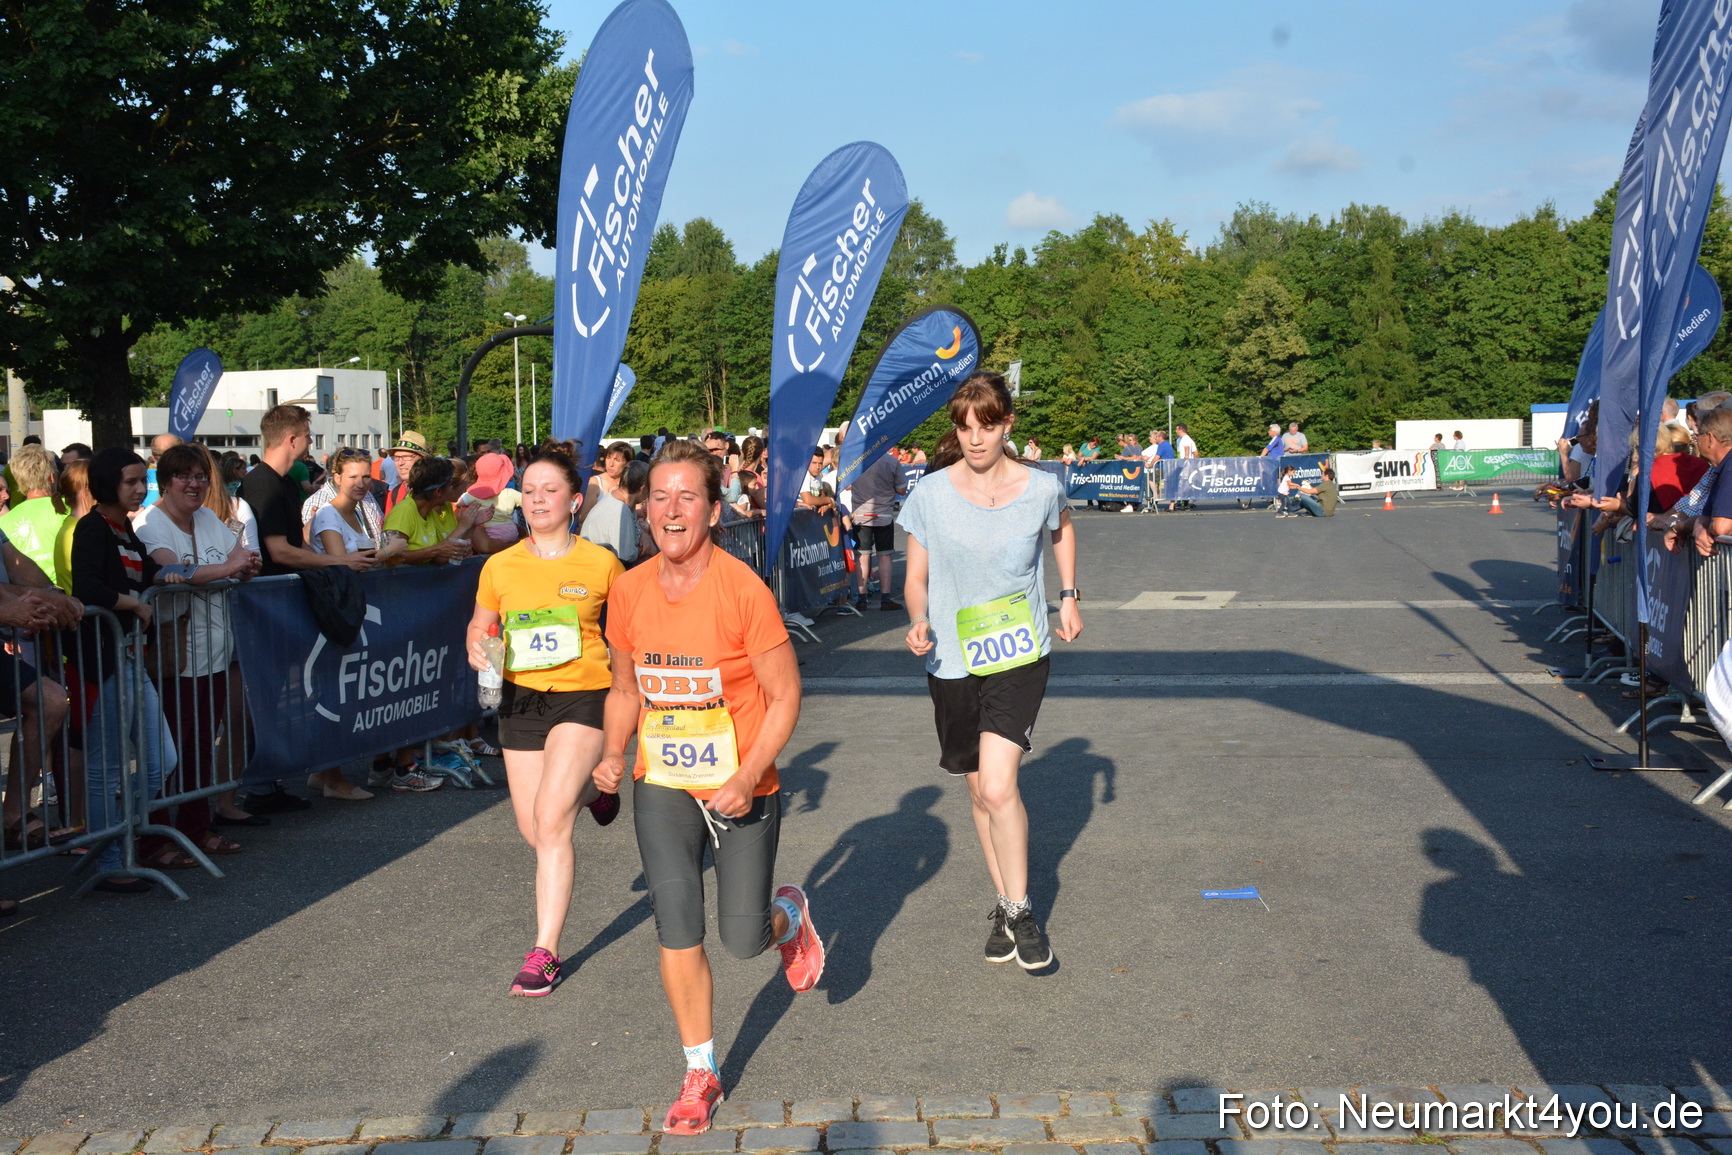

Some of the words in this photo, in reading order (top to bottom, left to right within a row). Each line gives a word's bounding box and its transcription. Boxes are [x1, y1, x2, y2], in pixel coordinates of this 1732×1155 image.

[1665, 0, 1732, 239] Fische
[587, 48, 659, 298] Fischer
[616, 91, 669, 293] AUTOMOBILE
[805, 177, 876, 346] Fischer
[831, 207, 886, 342] AUTOMOBILE
[1677, 308, 1711, 341] Medien
[181, 361, 212, 422] Fischer
[191, 372, 215, 420] AUTOMOBILE
[856, 361, 944, 436] Frischmann
[912, 384, 935, 405] Druck
[947, 353, 975, 380] Medien
[1201, 474, 1261, 487] Fischer
[1373, 459, 1411, 479] swn
[1444, 454, 1475, 471] AOK
[1206, 486, 1257, 494] AUTOMOBILE
[529, 631, 559, 652] 45
[643, 652, 661, 666] 30
[665, 653, 704, 667] Jahre
[966, 627, 1034, 668] 2003
[338, 640, 449, 704] Fischer
[640, 674, 714, 695] OBI
[352, 689, 440, 733] AUTOMOBILE
[661, 742, 719, 768] 594
